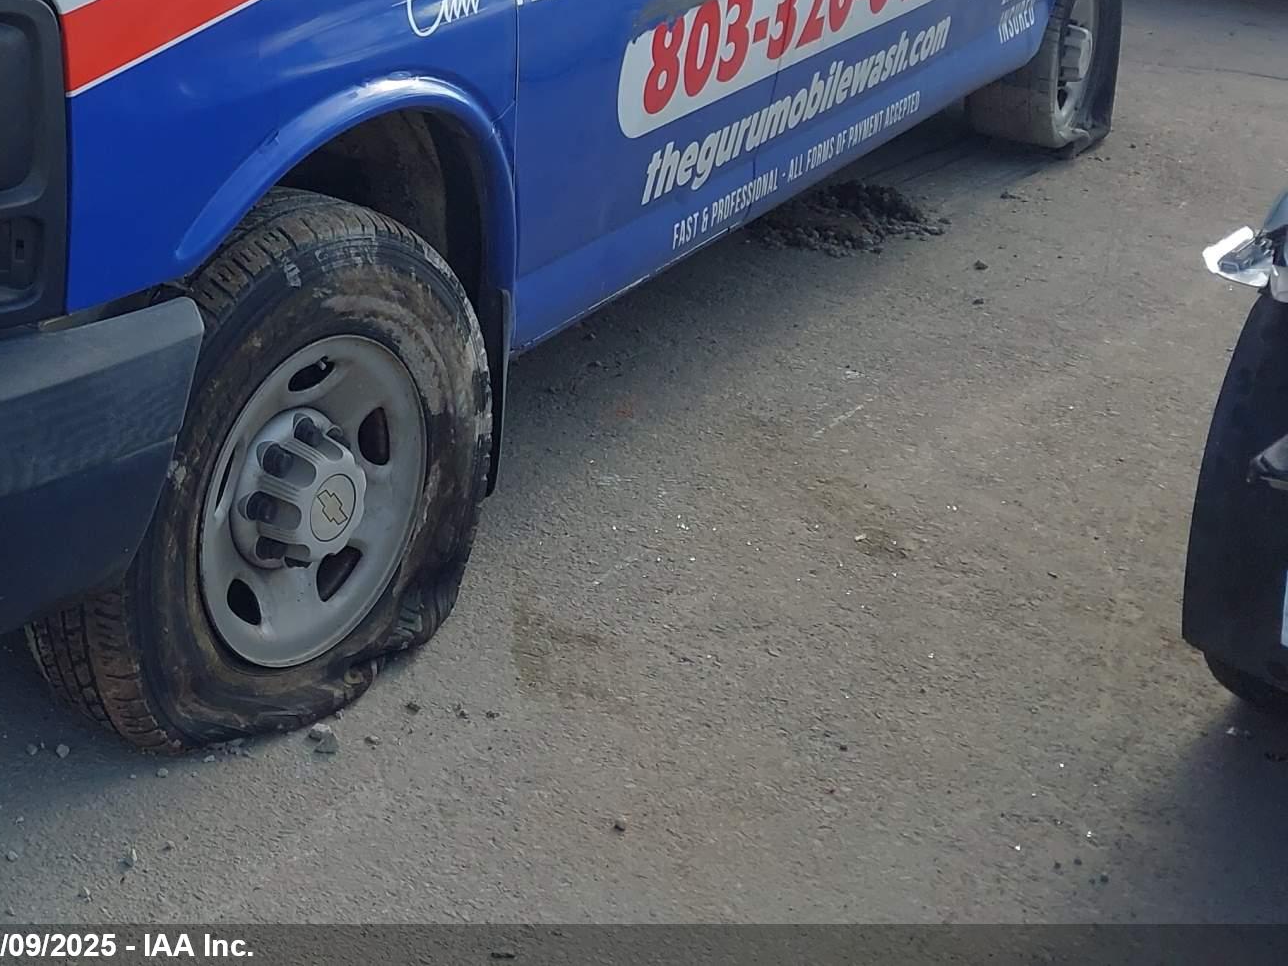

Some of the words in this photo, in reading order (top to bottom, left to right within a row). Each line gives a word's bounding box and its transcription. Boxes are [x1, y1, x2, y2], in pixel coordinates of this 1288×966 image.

[641, 16, 952, 205] thegurumobilewash.com
[672, 216, 699, 250] FAST
[701, 208, 709, 232] &
[711, 166, 778, 225] PROFESSIONAL
[787, 156, 804, 182] ALL
[806, 139, 835, 175] FORMS
[836, 134, 846, 161] OF
[848, 109, 884, 150] PAYMENT
[884, 90, 921, 130] ACCEPTED
